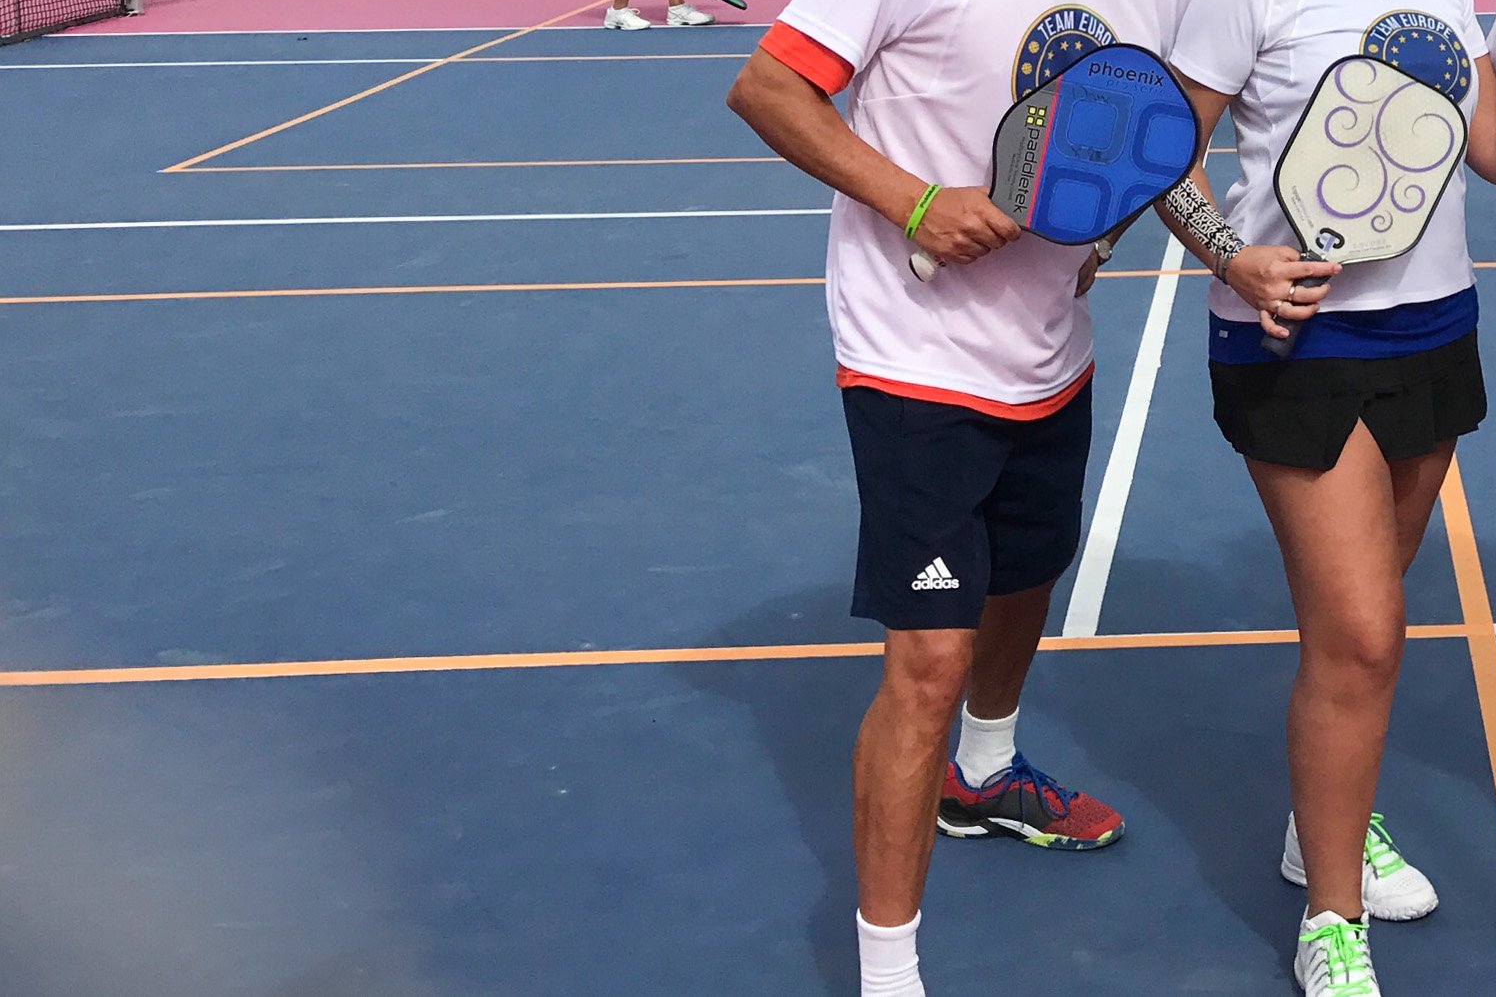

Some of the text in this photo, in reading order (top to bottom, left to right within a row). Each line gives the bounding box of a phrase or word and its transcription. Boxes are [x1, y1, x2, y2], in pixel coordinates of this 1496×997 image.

[1037, 10, 1118, 46] TEAM EURO
[1399, 13, 1452, 39] EUROPE
[1088, 61, 1165, 87] phoenix
[1012, 127, 1041, 214] paddletek
[911, 577, 960, 591] adidas
